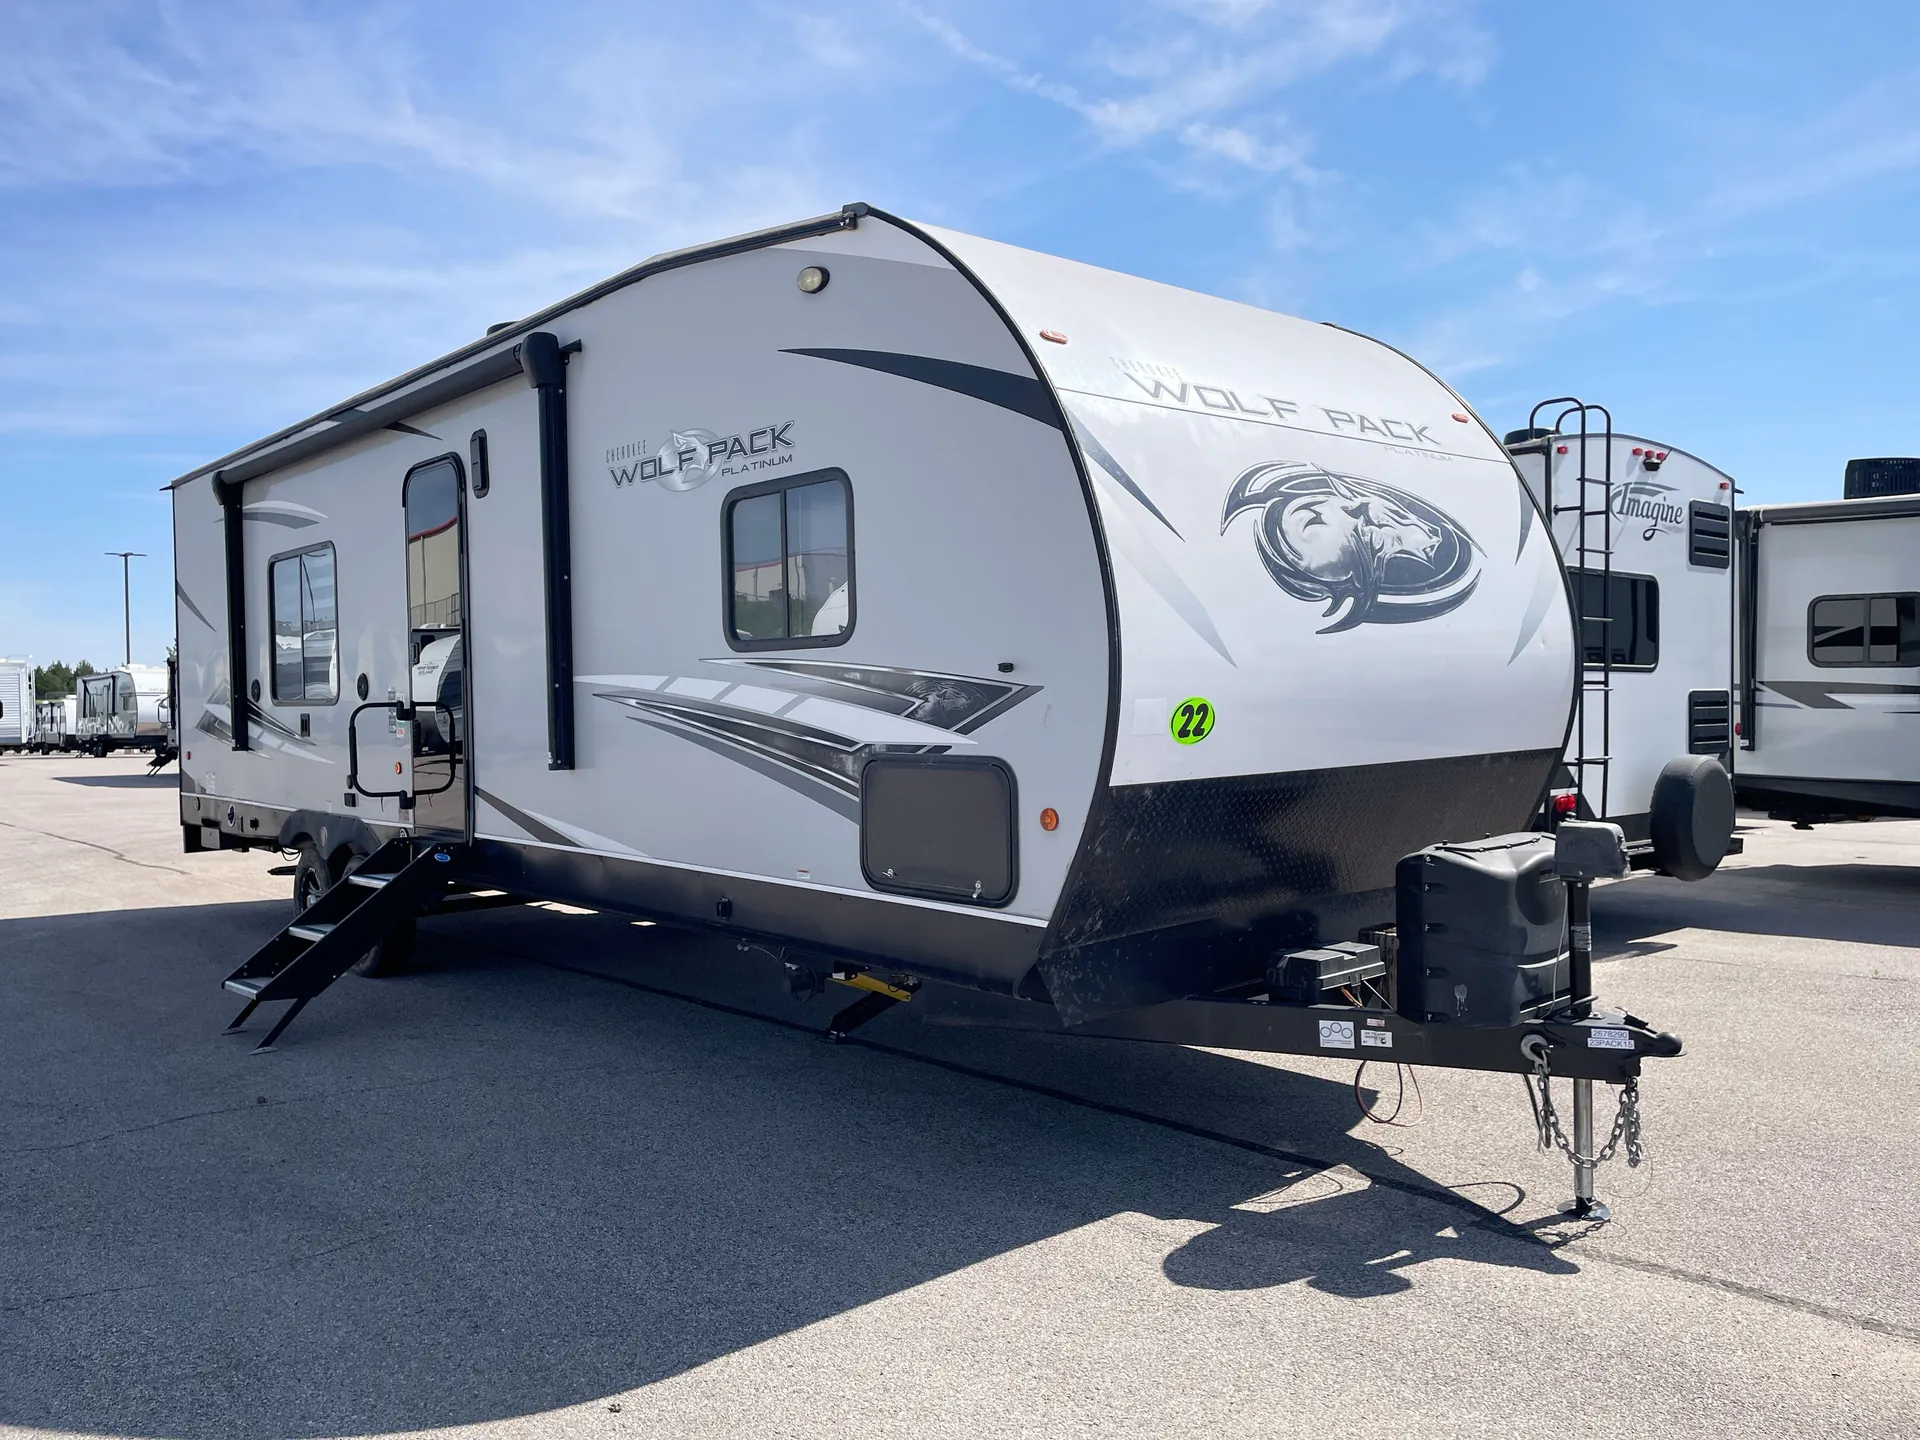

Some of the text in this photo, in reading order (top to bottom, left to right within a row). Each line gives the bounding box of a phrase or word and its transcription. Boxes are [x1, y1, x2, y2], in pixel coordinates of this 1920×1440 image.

[1123, 371, 1443, 447] WOLF PACK
[605, 439, 647, 463] CHEROKEE
[608, 420, 795, 489] WOLF PACK
[721, 453, 793, 477] PLATINUM
[1384, 445, 1453, 463] PLATINUM
[1615, 483, 1685, 541] Imagine
[1177, 702, 1209, 738] 22
[1589, 1039, 1634, 1049] 23PACK15
